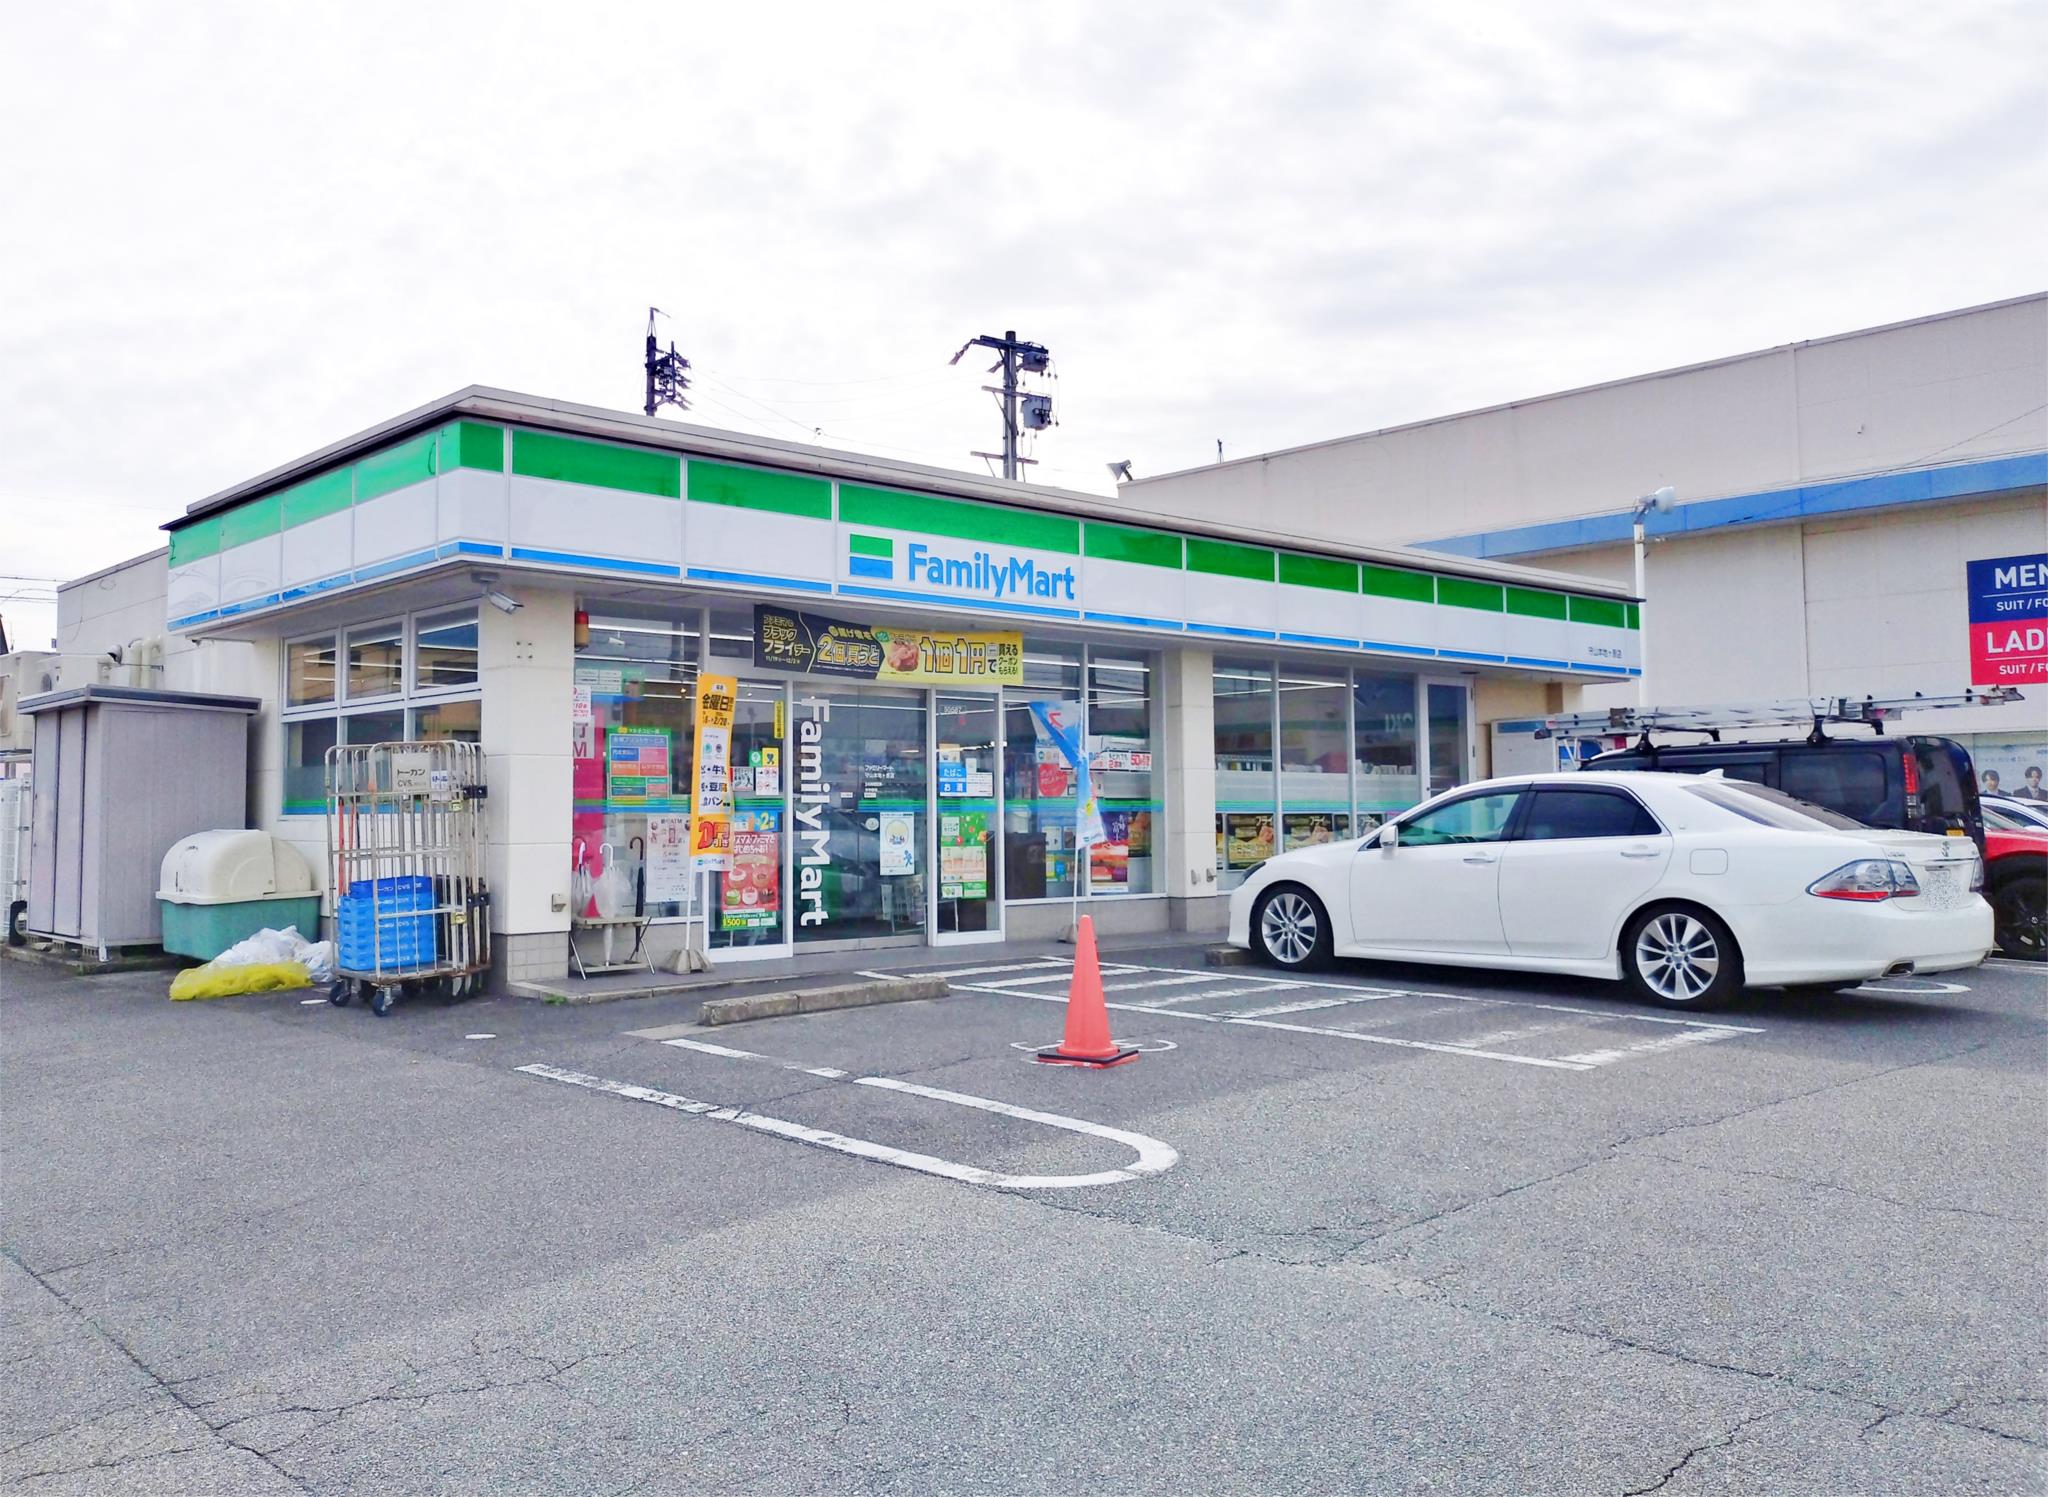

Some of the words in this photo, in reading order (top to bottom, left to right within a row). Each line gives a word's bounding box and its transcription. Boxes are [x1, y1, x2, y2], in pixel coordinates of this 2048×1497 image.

[908, 543, 1075, 600] FamilyMart
[1996, 600, 2025, 611] SUIT
[763, 639, 811, 656] フライデー
[817, 633, 880, 667] 2個買うと
[1986, 628, 2048, 653] LAD
[920, 636, 985, 674] 1個1円
[1999, 664, 2027, 675] SUIT
[397, 768, 426, 777] トーカン
[943, 768, 963, 778] たばこ
[796, 699, 830, 926] FamilyMart
